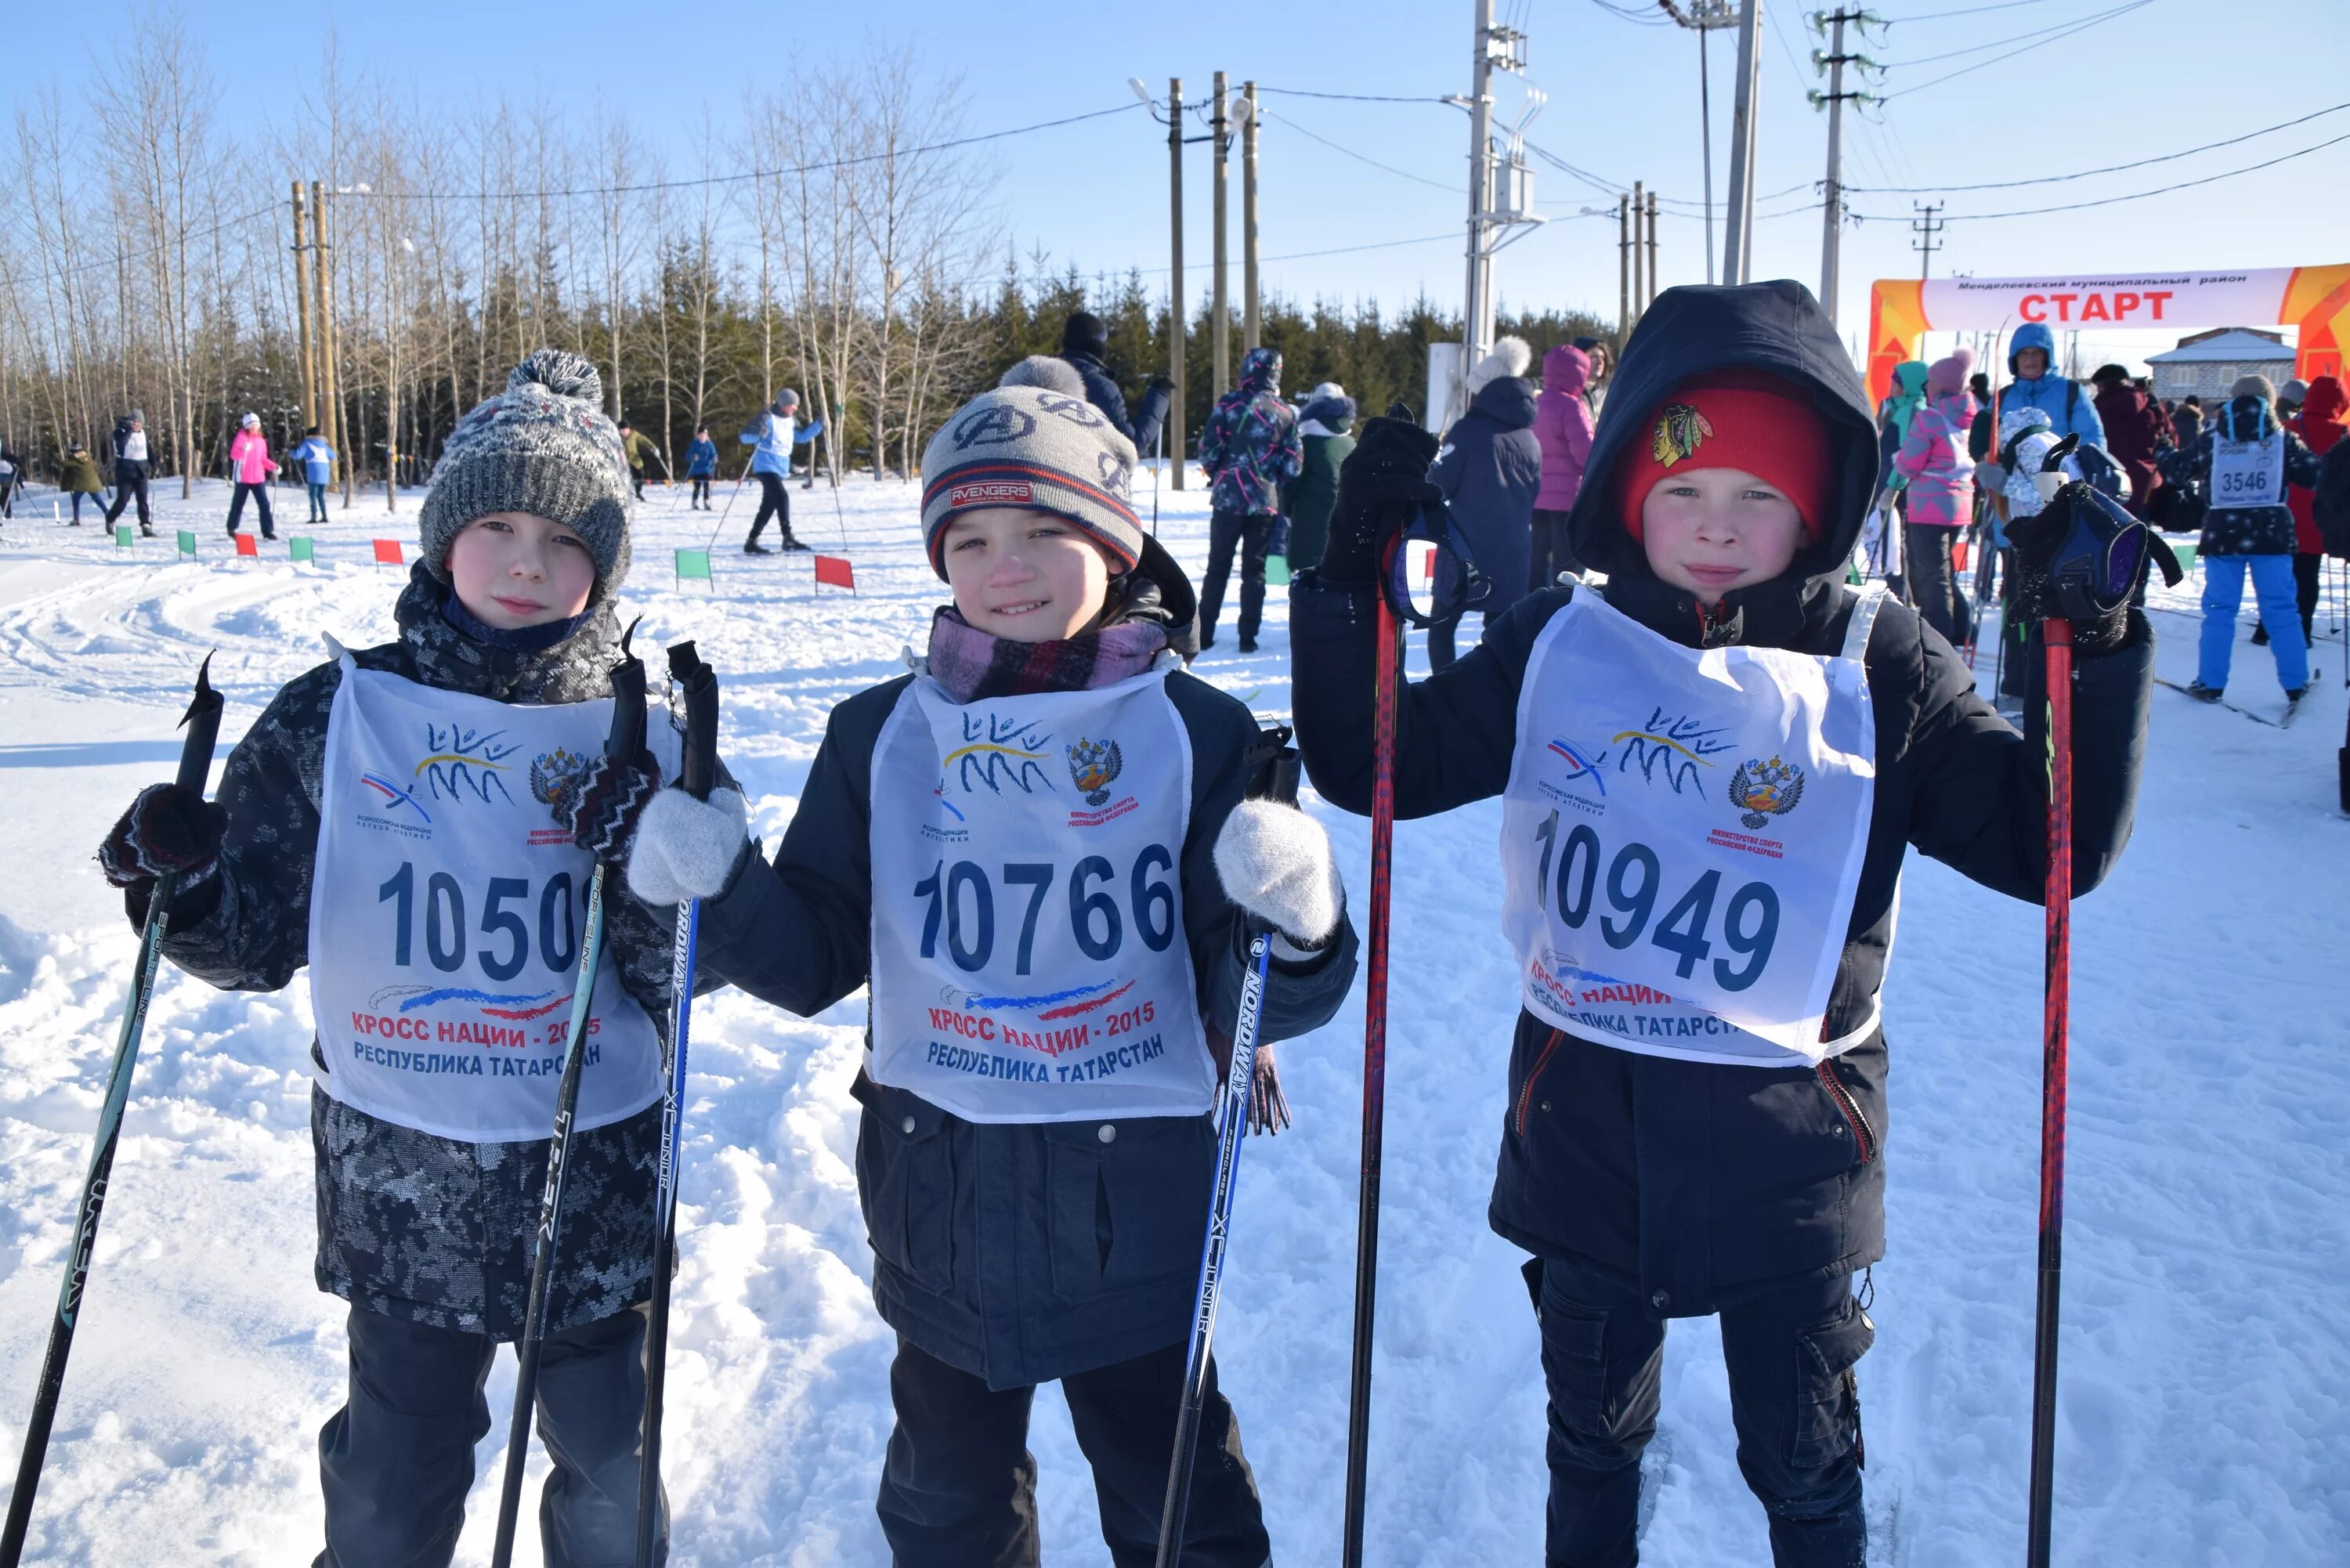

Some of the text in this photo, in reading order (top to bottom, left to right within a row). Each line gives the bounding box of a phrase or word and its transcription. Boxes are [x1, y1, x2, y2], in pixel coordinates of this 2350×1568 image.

[1958, 274, 2247, 290] Менделеевский муниципальный район
[2019, 291, 2173, 323] СТАРТ
[952, 485, 1029, 501] AVENGERS
[2222, 471, 2267, 492] 3546
[1112, 796, 1135, 810] СПОРТА
[1563, 800, 1604, 817] АТЛЕТИКИ
[1574, 796, 1605, 810] ФЕДЕРАЦИЯ
[1706, 836, 1784, 859] РОССИЙСКОЙ ФЕДЕРАЦИИ
[1711, 828, 1784, 850] МИНИСТЕРСТВО СПОРТА
[580, 863, 604, 974] SPORTSLINE
[913, 844, 1175, 975] 10766
[1535, 807, 1781, 992] 10949
[136, 911, 168, 1027] SPORTSLINE
[673, 896, 692, 1003] ORDWAY
[1531, 957, 1672, 1007] КРОСС НАЦИИ
[352, 1011, 430, 1041] КРОСС
[437, 1021, 526, 1049] НАЦИИ
[548, 1017, 601, 1045] 205
[667, 1017, 677, 1077] FIBERGLASS
[927, 1008, 996, 1040] КРОСС
[1002, 1024, 1090, 1058] НАЦИИ
[1106, 1000, 1155, 1036] 2015
[1231, 971, 1262, 1108] NORDWAY
[1634, 1015, 1740, 1036] ТАТАРСТ
[353, 1041, 483, 1076] РЕСПУБЛИКА
[927, 1033, 1165, 1083] РЕСПУБЛИКА ТАТАРСТАН
[660, 1132, 673, 1189] JUNIOR
[1219, 1128, 1235, 1198] FIBERGLASS
[1198, 1212, 1229, 1333] XC JUNIOR
